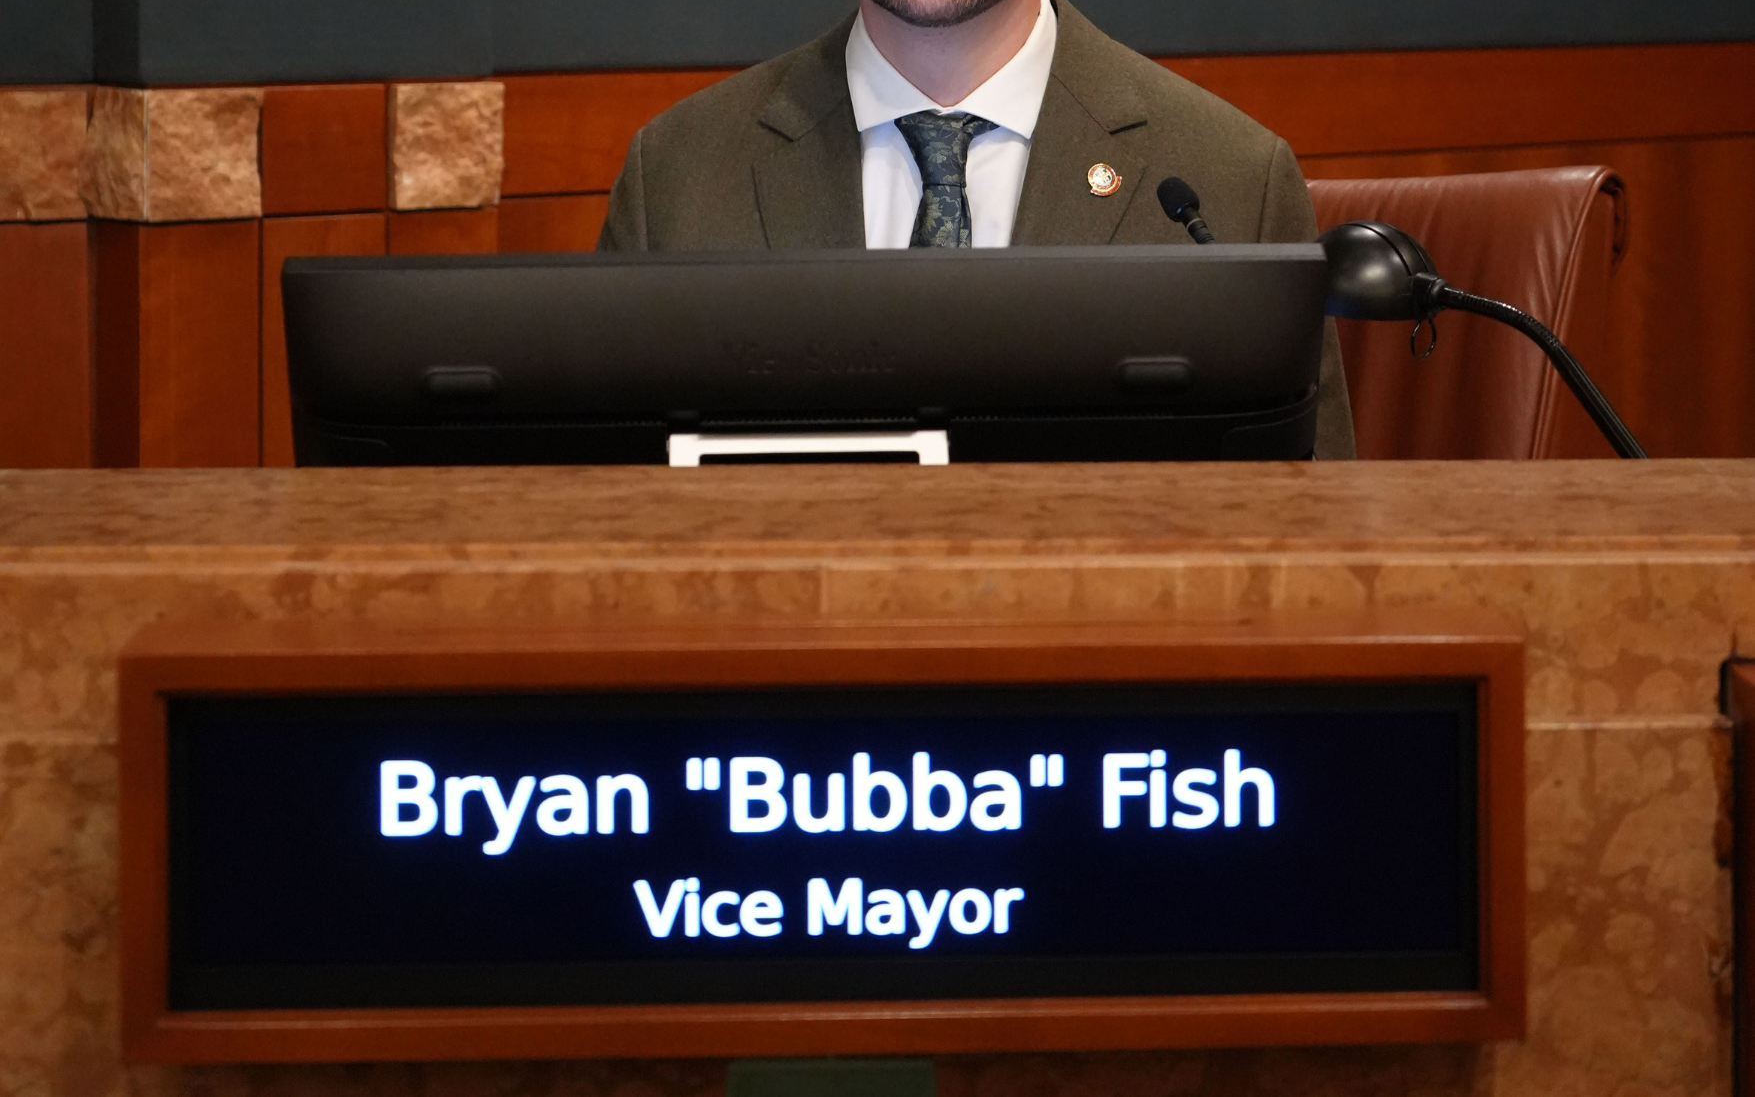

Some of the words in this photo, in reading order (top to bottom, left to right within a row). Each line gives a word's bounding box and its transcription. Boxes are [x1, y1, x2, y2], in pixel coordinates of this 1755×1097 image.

[379, 760, 649, 856] Bryan
[686, 752, 1064, 834] "Bubba"
[1103, 749, 1276, 830] Fish
[633, 877, 784, 938] Vice
[807, 878, 1025, 949] Mayor
